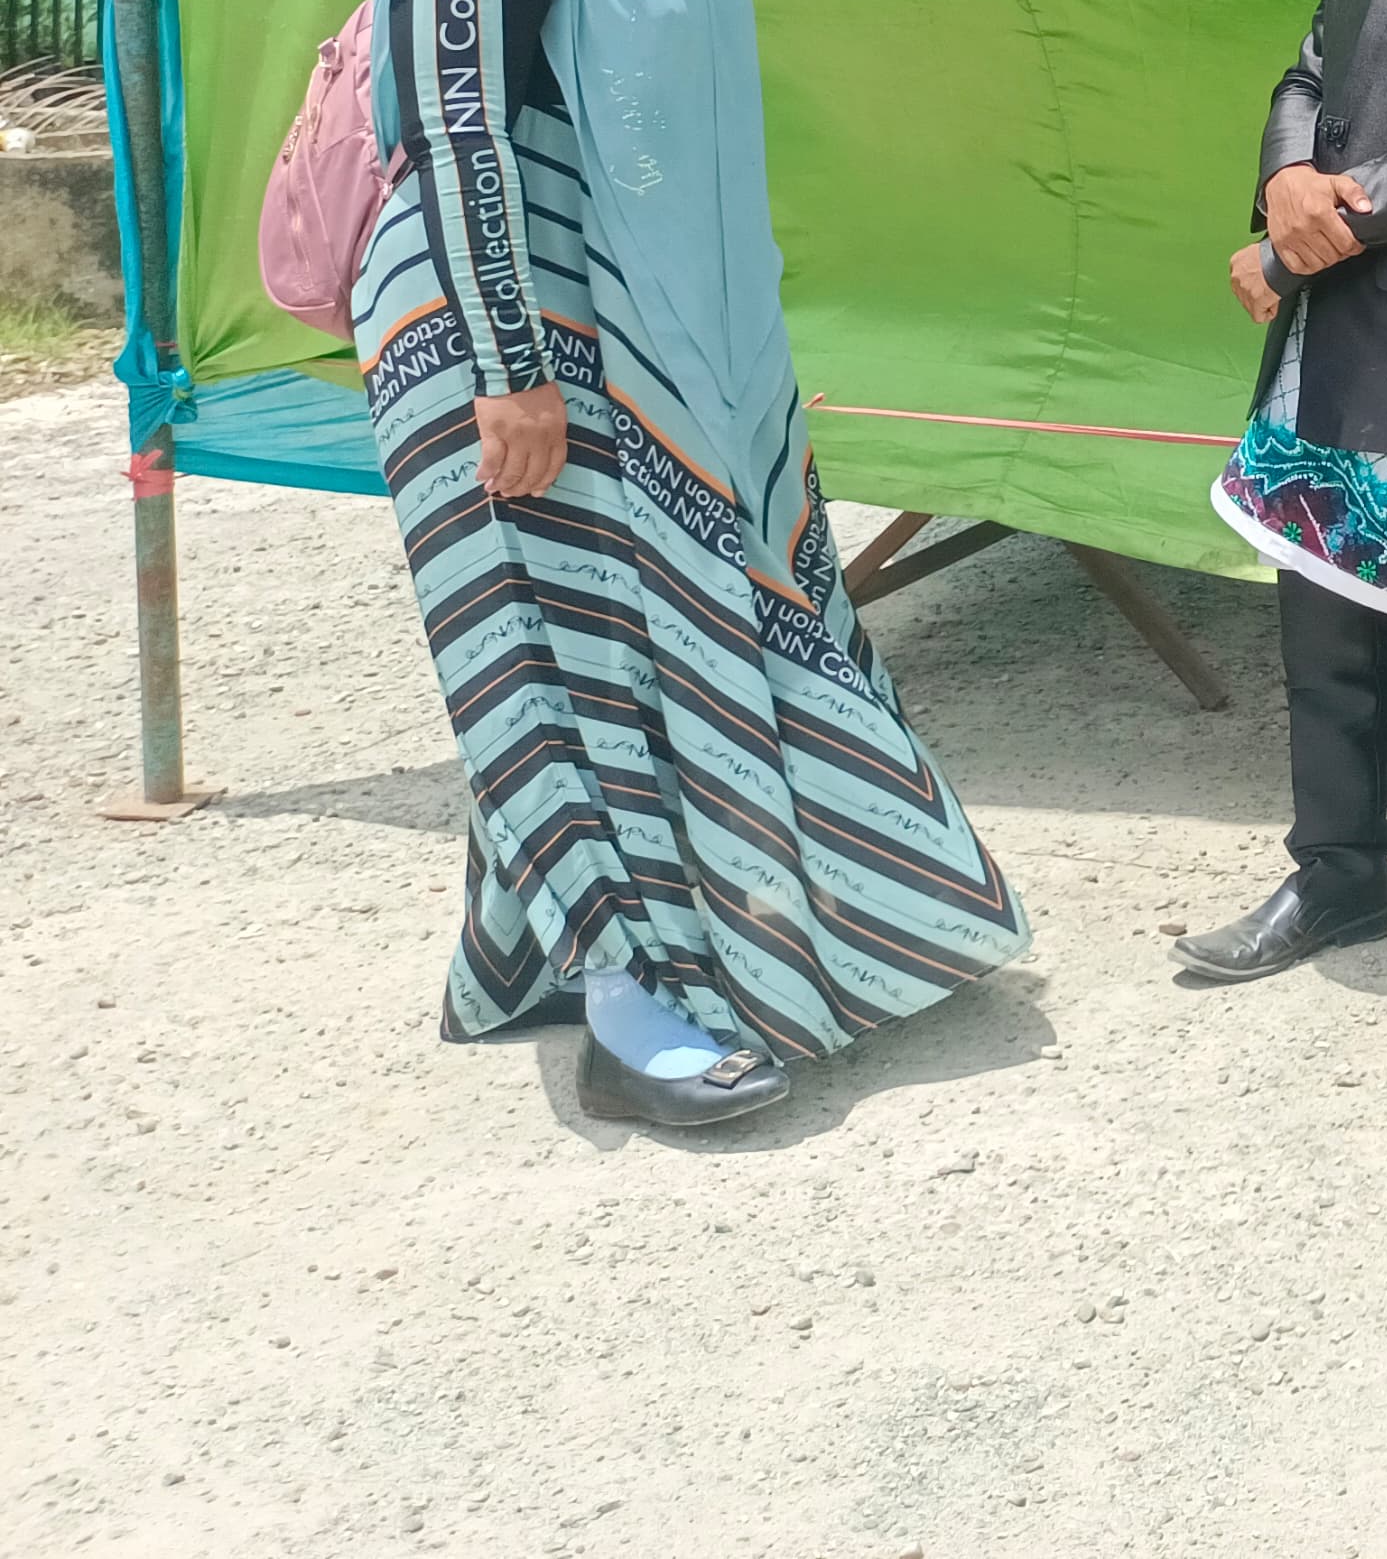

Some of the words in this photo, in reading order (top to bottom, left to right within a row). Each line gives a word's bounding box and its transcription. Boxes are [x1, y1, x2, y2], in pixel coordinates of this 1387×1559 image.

[441, 67, 486, 135] NN
[468, 148, 527, 330] Collection
[398, 343, 441, 386] NN
[549, 329, 596, 364] NN
[645, 444, 683, 489] NN
[672, 496, 716, 540] NN
[766, 621, 816, 661] NN
